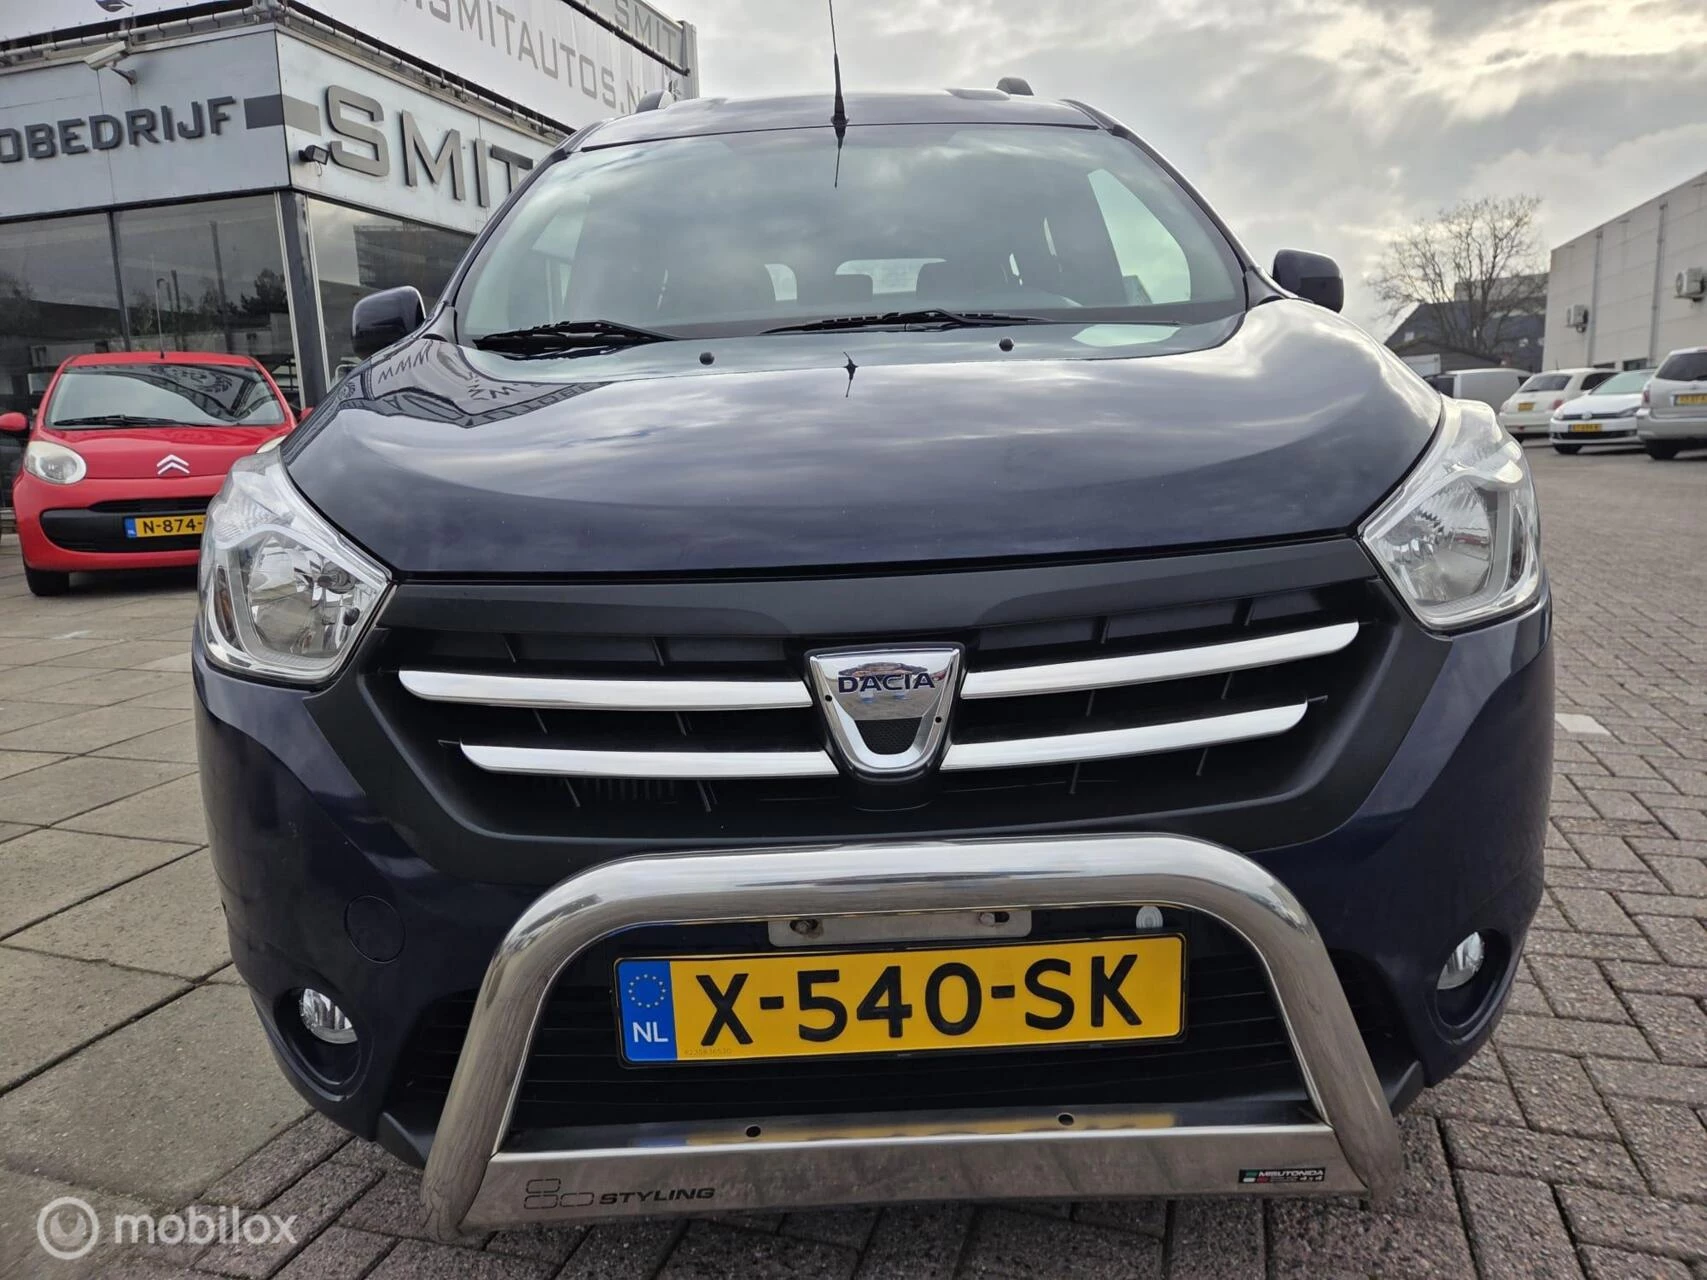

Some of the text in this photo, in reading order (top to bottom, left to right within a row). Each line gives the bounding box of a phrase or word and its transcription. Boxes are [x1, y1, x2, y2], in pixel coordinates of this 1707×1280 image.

[326, 85, 533, 208] SMIT
[838, 672, 935, 693] DACIA
[632, 954, 1143, 1047] NL X-540-SK
[599, 1187, 716, 1205] STYLING
